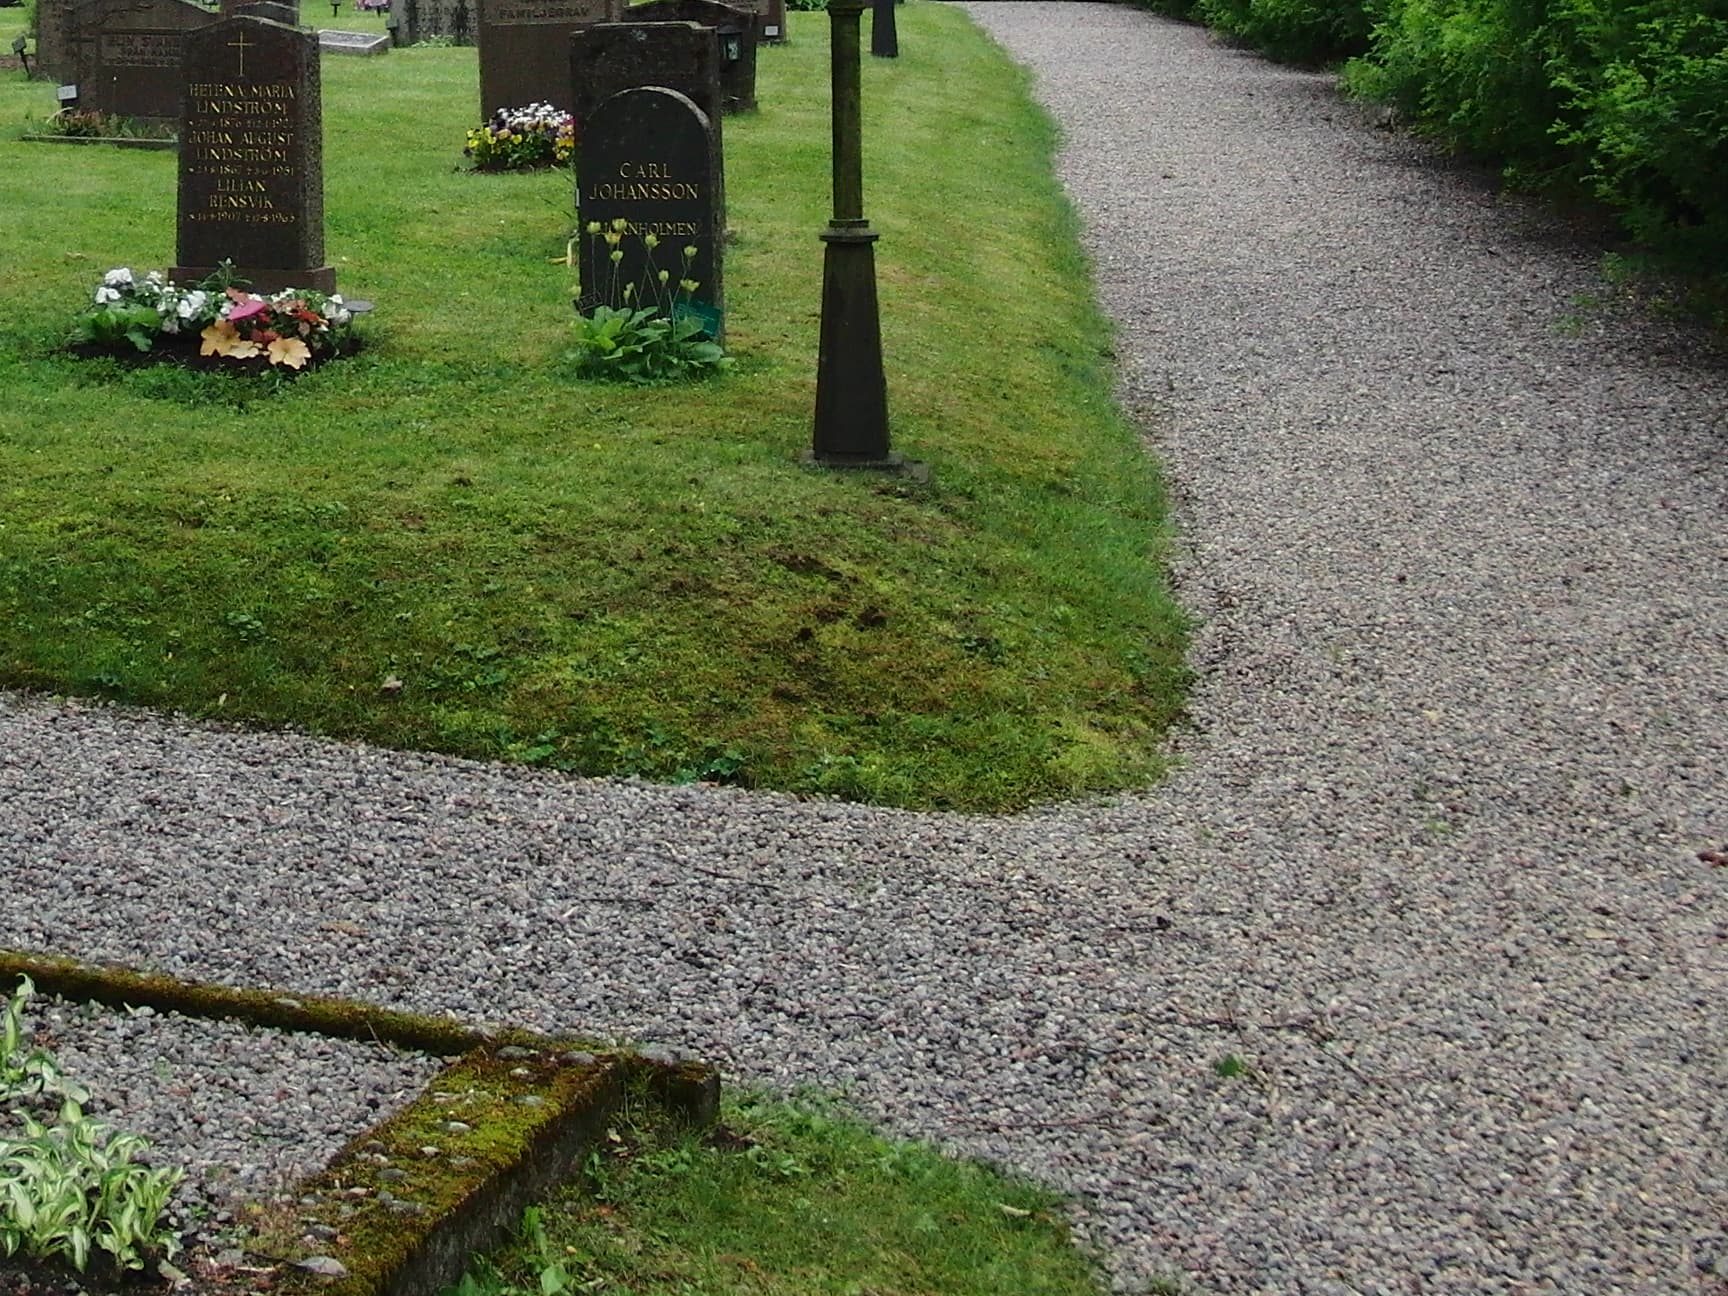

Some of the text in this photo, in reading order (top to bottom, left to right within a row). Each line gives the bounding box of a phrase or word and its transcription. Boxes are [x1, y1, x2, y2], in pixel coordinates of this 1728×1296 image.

[188, 83, 296, 99] HELENA MARIA
[197, 99, 287, 115] LINDSTRÖM
[188, 131, 295, 145] JOHAN AUGUST
[196, 146, 287, 162] LINDSTRÖM
[619, 162, 672, 178] CARL
[217, 179, 266, 192] LILIAN
[588, 183, 699, 200] JOHANSSON
[209, 194, 273, 209] RENSVIK
